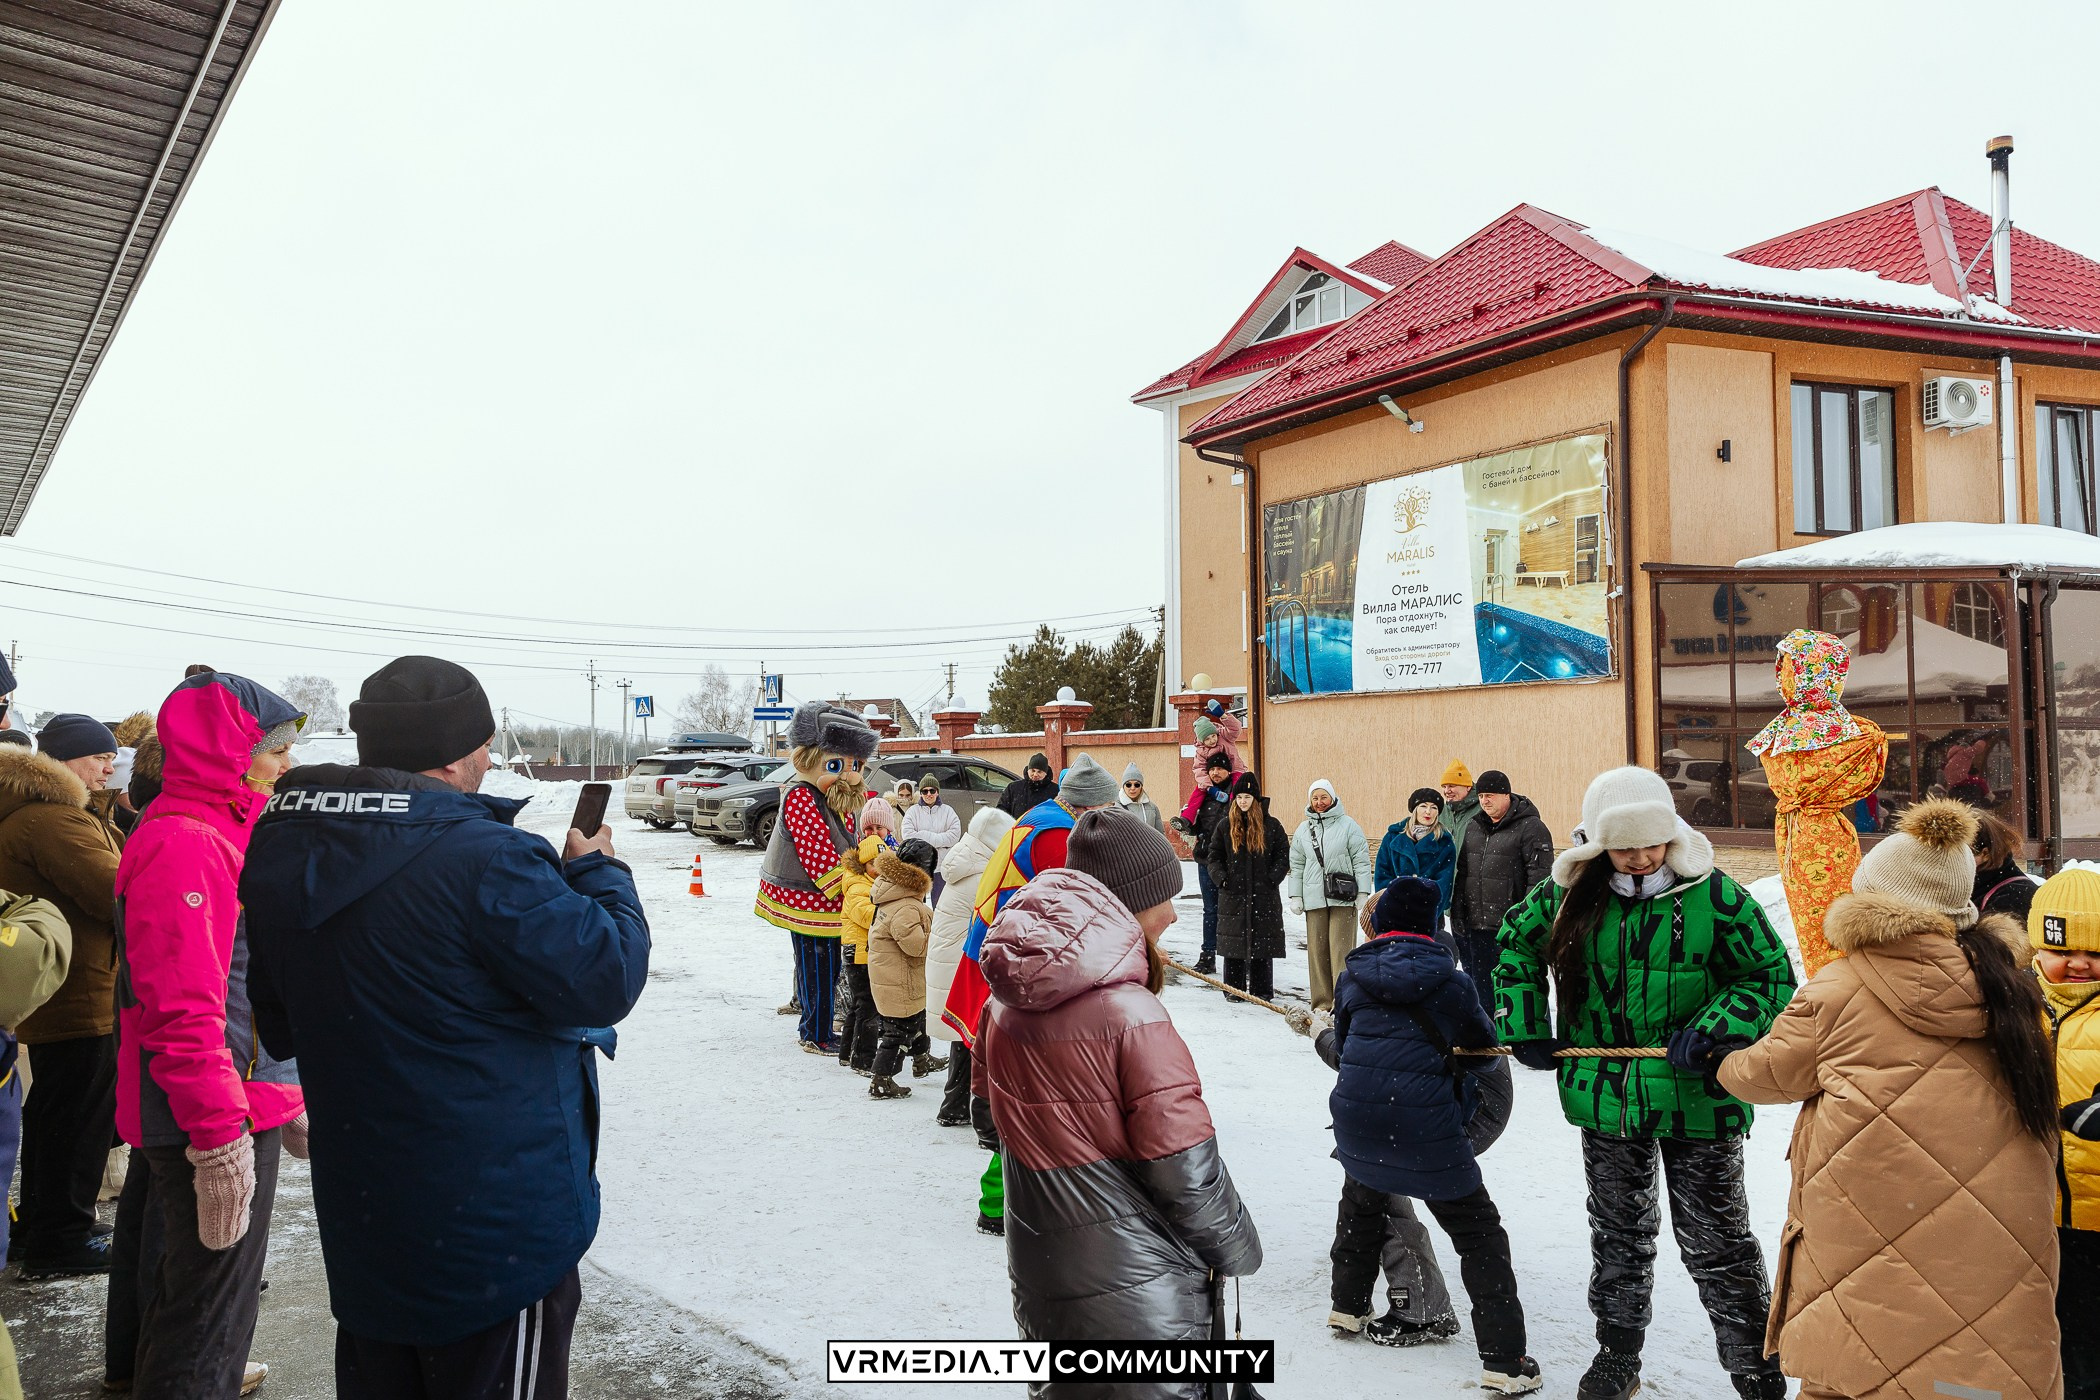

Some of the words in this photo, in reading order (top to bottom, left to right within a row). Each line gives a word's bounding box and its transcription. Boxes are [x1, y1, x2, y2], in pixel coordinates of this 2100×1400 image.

[1482, 466, 1515, 480] Гостевой
[1516, 464, 1532, 474] дом
[1488, 477, 1511, 489] баней
[1519, 468, 1561, 483] бассейном
[1284, 512, 1302, 522] гостей
[1273, 539, 1295, 549] бассейн
[1276, 548, 1293, 556] сауна
[1386, 545, 1435, 564] MARALIS
[1391, 584, 1429, 596] Отель
[1362, 602, 1397, 615] Вилла
[1400, 592, 1463, 610] МАРАЛИС
[1376, 615, 1397, 625] Пора
[1398, 611, 1447, 622] отдохнуть,
[1384, 626, 1399, 635] как
[1400, 621, 1438, 634] следует!
[1365, 647, 1402, 655] Обратитесь
[1408, 642, 1460, 652] администратору
[1400, 652, 1426, 660] стороны
[1427, 650, 1451, 659] дороги
[1398, 661, 1442, 676] 772-777
[2045, 919, 2062, 931] GL
